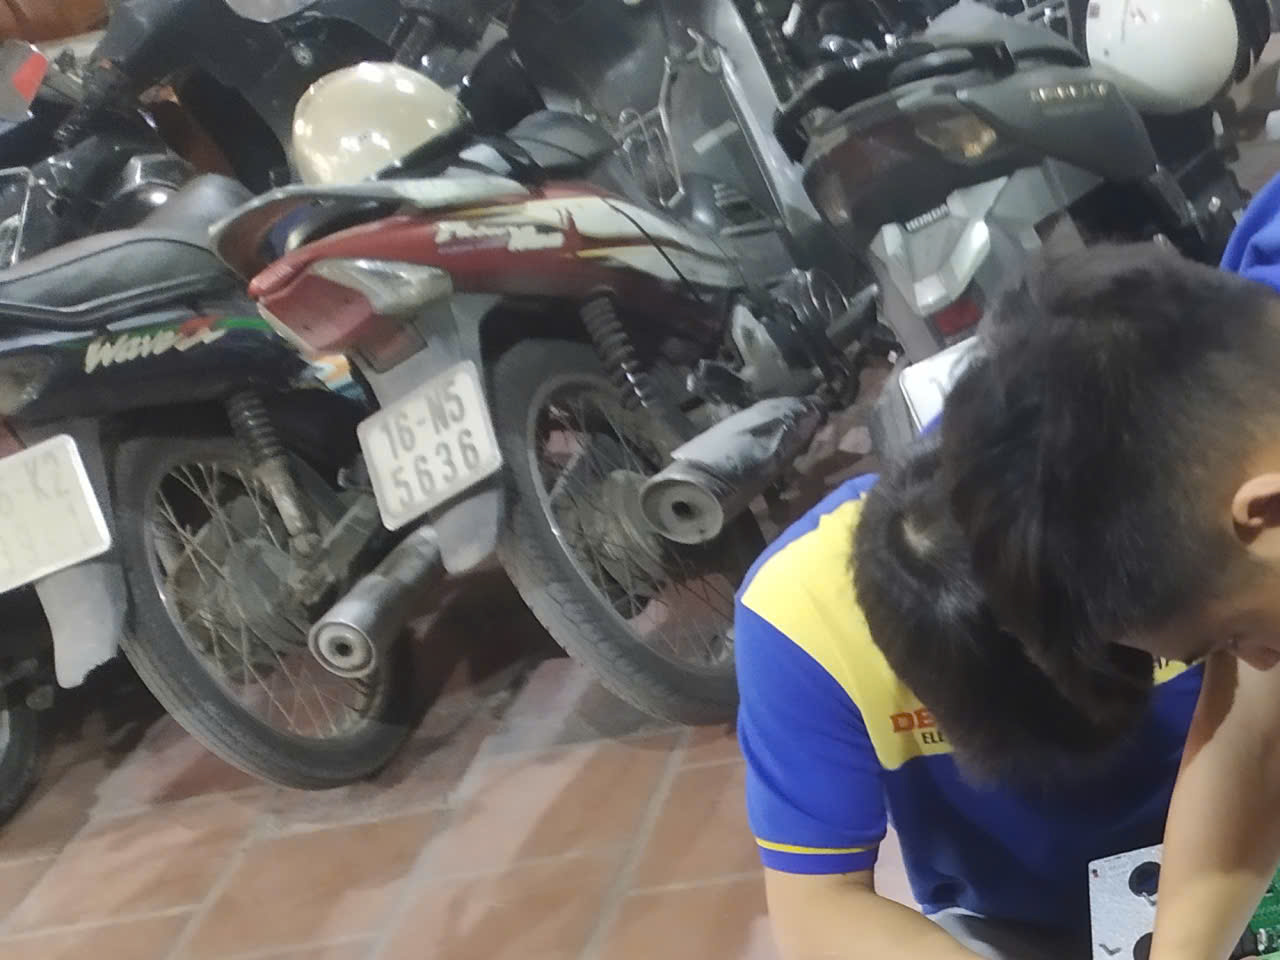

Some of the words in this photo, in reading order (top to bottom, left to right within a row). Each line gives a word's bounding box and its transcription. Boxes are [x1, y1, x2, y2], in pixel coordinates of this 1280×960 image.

[904, 203, 950, 232] HONDA
[381, 378, 465, 461] 16-N5
[391, 428, 480, 507] 5636
